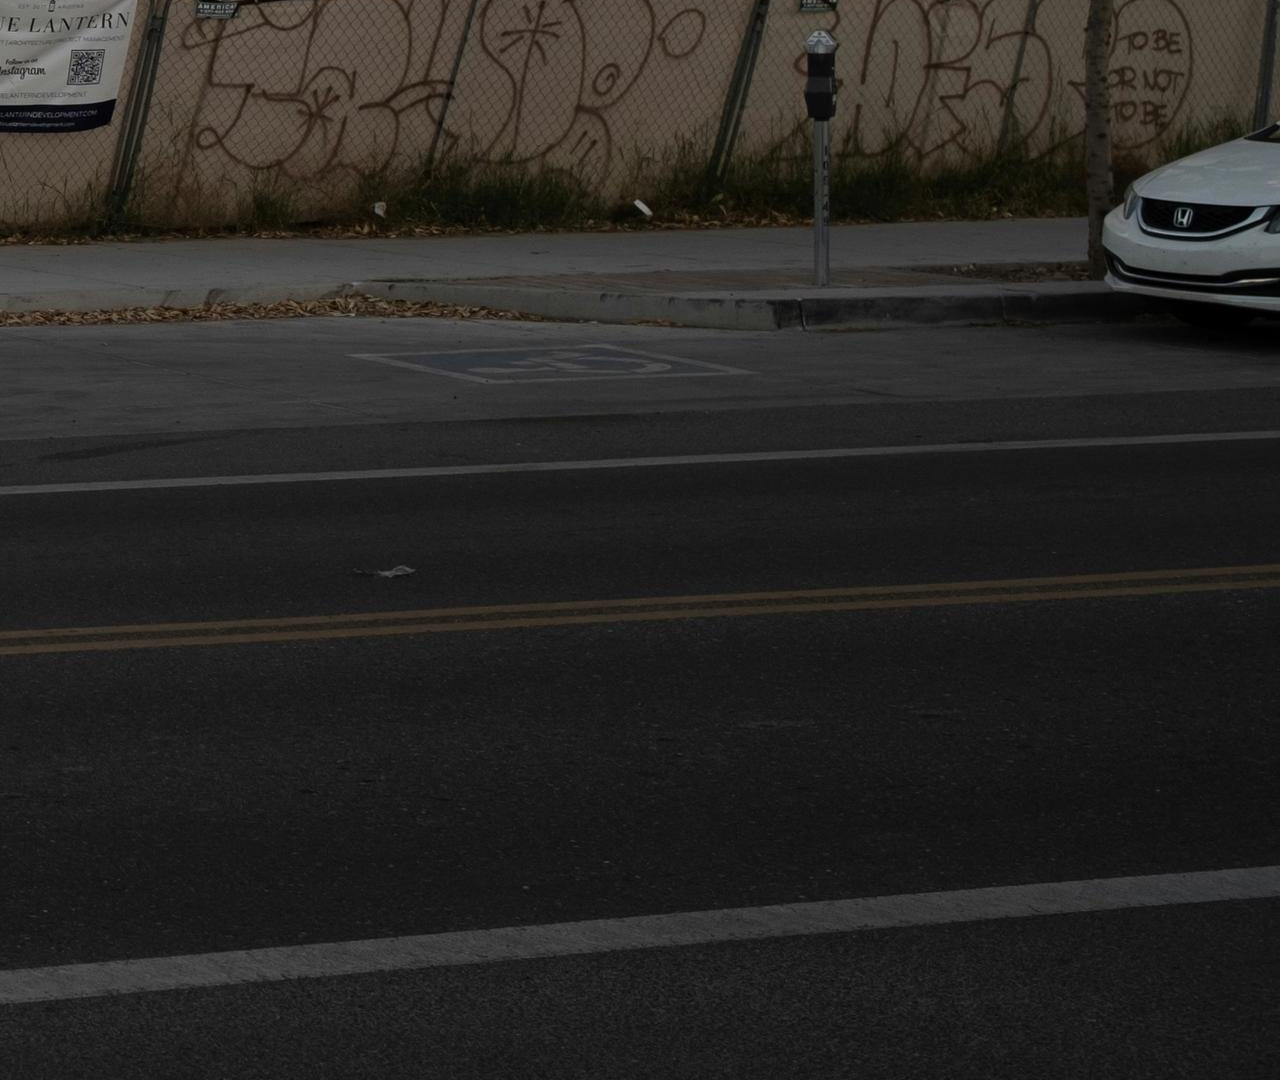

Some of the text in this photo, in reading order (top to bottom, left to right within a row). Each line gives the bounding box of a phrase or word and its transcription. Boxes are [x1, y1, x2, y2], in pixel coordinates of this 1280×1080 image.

[30, 12, 130, 32] LANTERN
[1117, 29, 1182, 54] TO BE
[1108, 66, 1185, 94] OR NOT
[1109, 101, 1167, 124] TO BE
